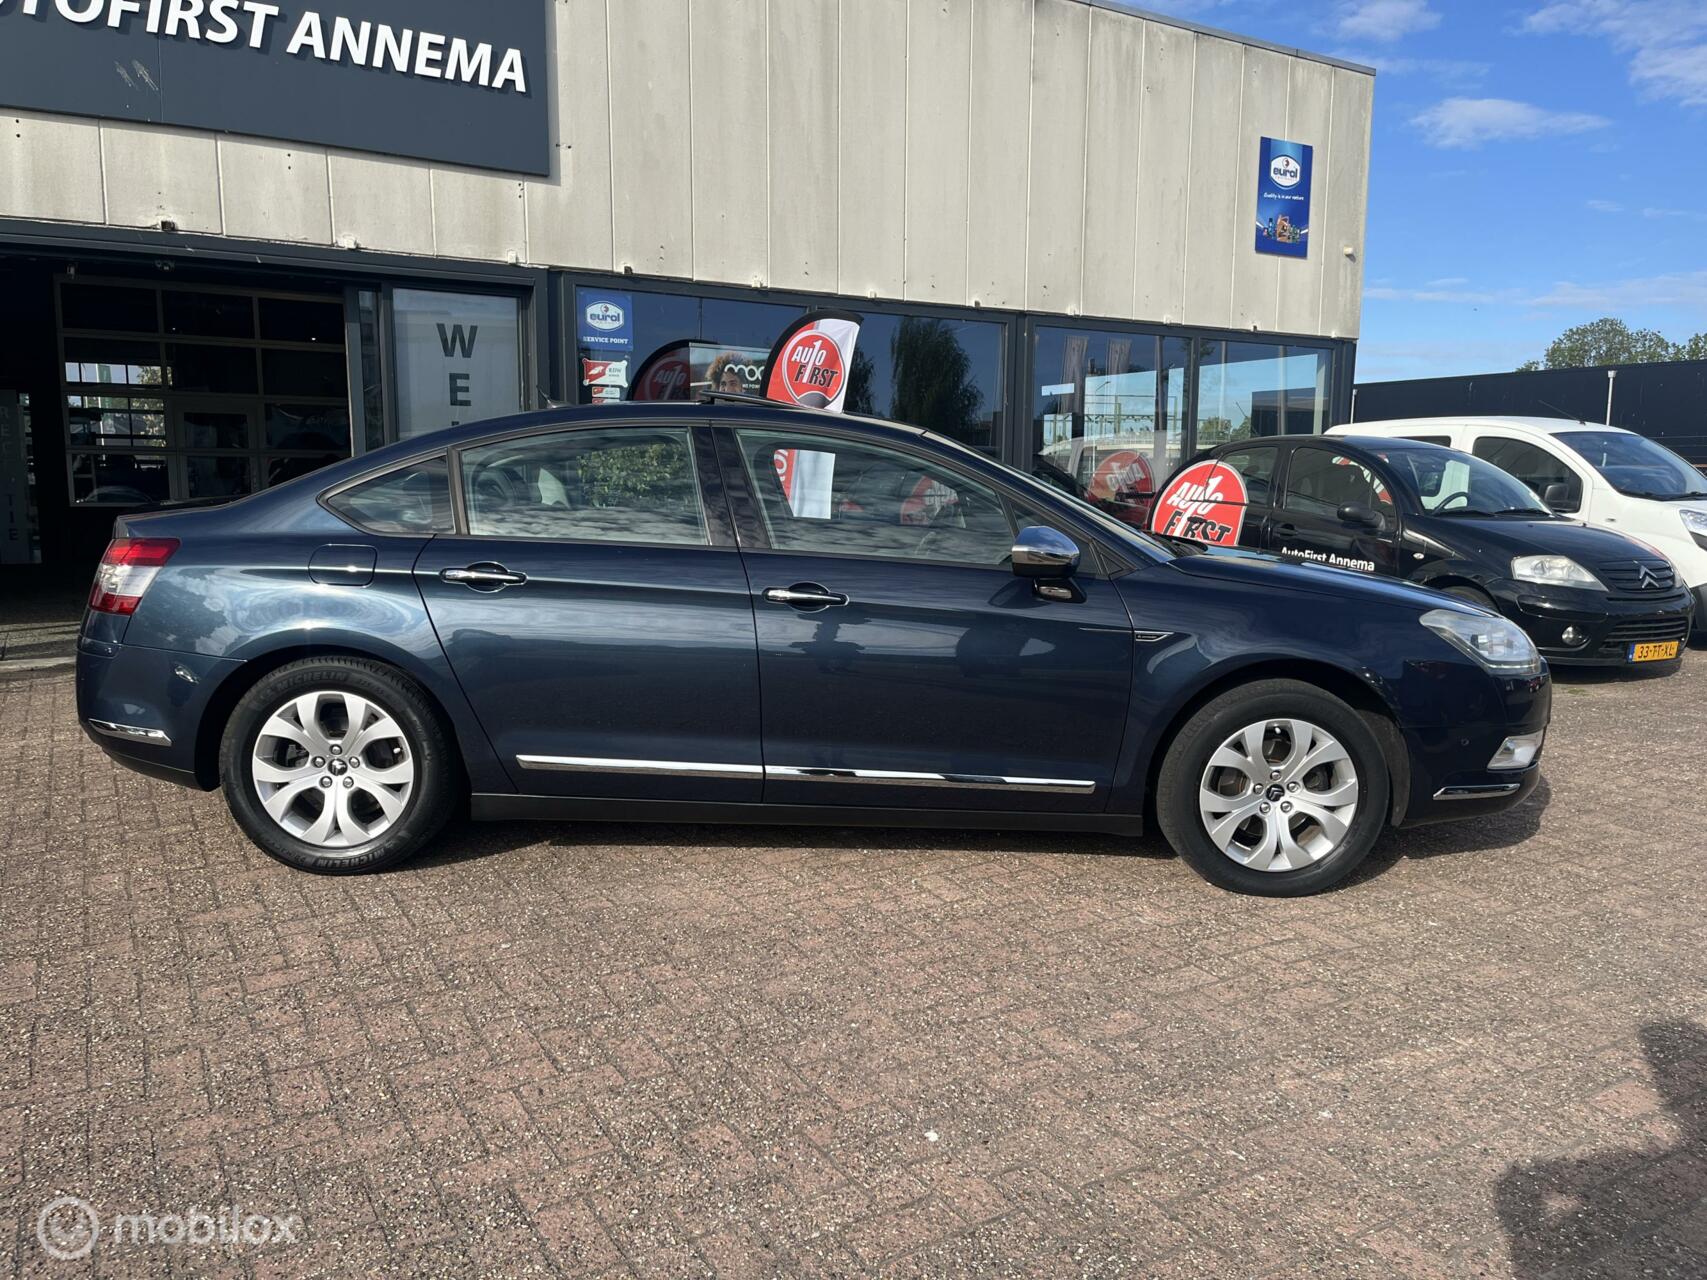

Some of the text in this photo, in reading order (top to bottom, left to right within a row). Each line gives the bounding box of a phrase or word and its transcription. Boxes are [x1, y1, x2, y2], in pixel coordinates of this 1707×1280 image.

[286, 11, 528, 93] ANNEMA
[1273, 166, 1298, 178] eurol
[589, 312, 620, 323] eurol
[582, 335, 629, 345] SERVICE POINT
[436, 322, 479, 426] WE
[1328, 553, 1375, 571] Annema
